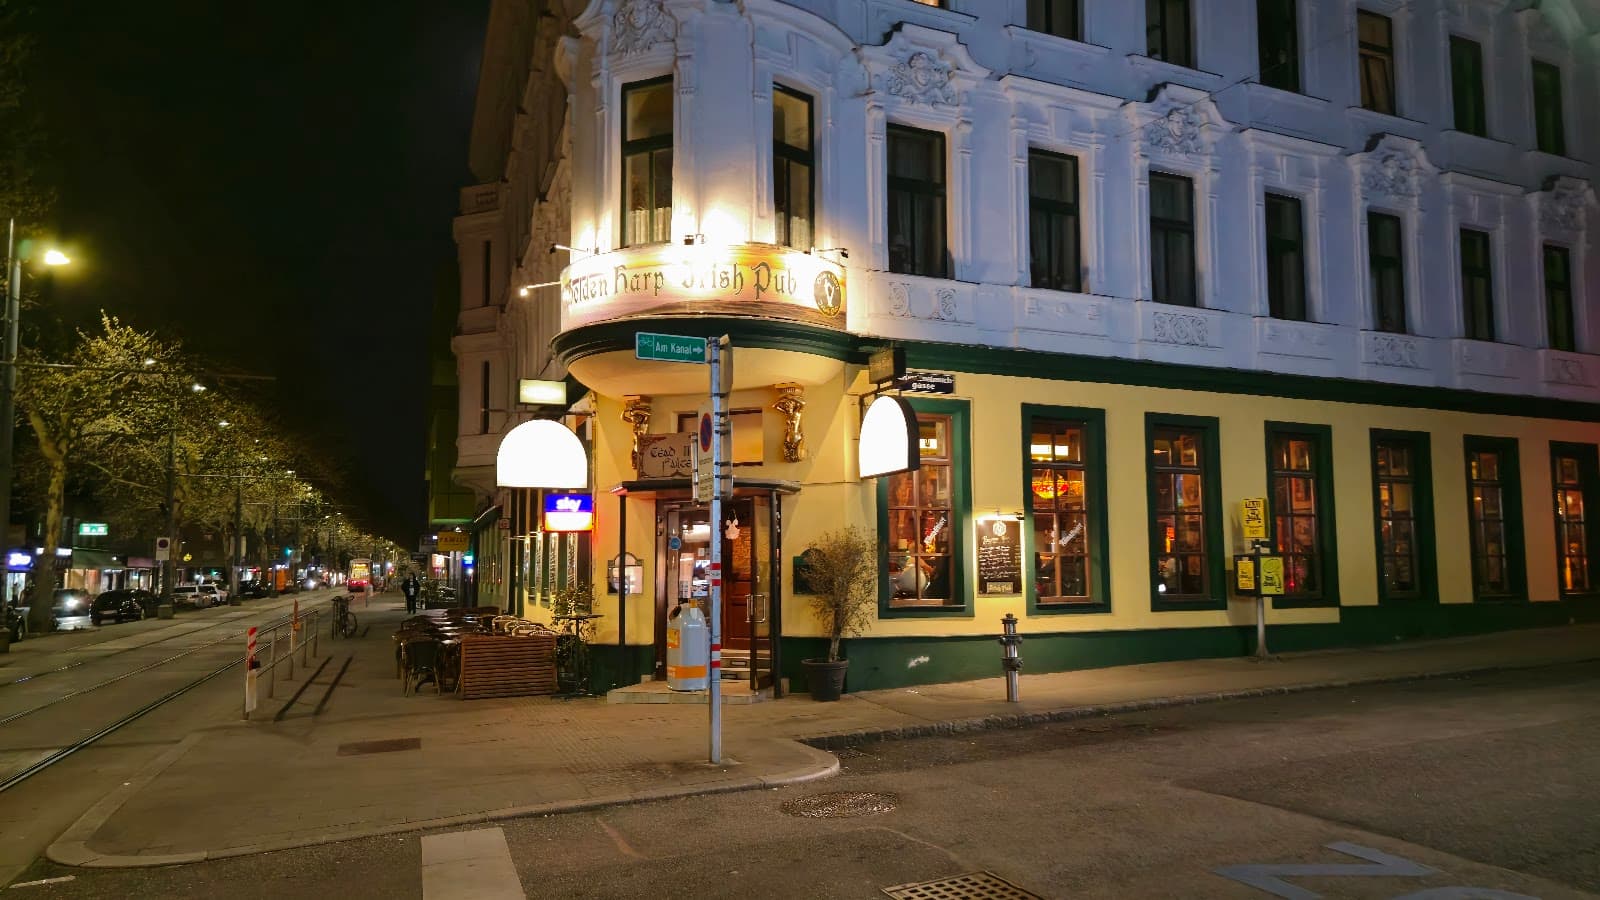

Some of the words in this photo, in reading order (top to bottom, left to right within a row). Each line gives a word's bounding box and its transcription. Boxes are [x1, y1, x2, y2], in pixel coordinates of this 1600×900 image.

[614, 264, 665, 297] Harp
[751, 261, 797, 300] Pub
[655, 341, 668, 352] Am
[670, 343, 692, 355] Kanal
[556, 496, 583, 513] sky
